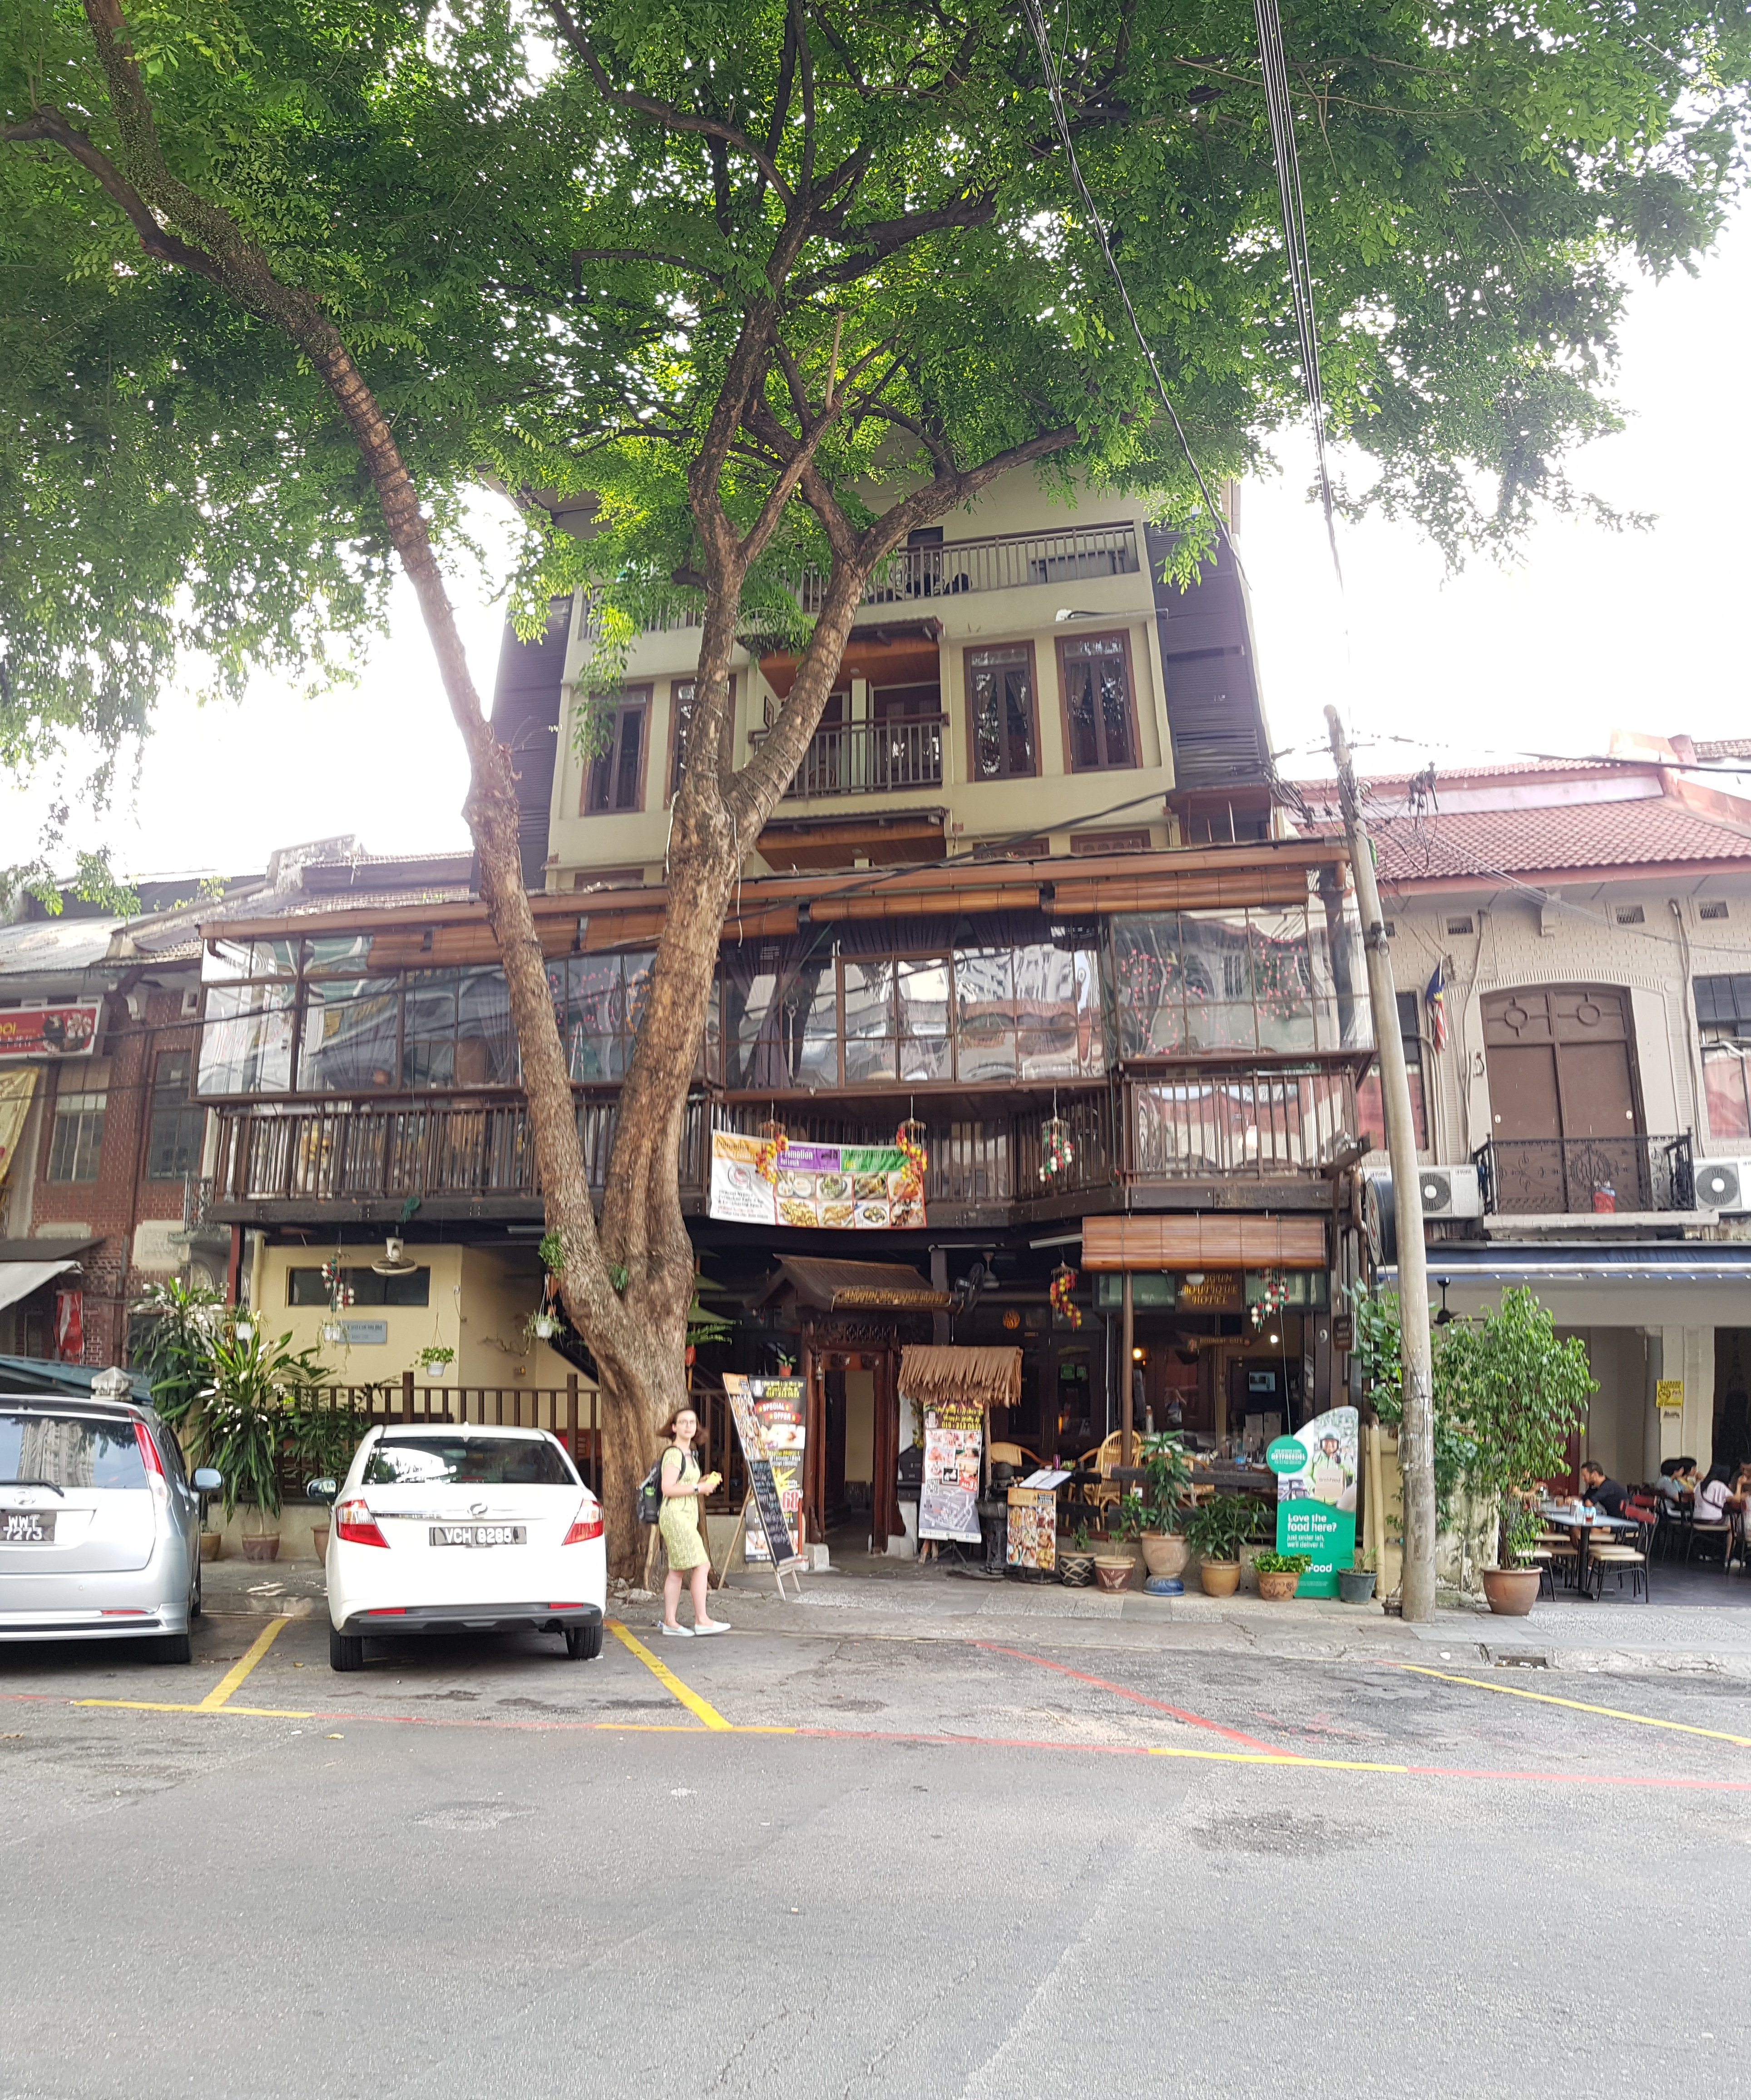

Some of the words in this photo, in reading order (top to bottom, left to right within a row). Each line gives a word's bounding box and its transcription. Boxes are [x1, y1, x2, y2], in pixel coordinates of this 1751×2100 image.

[1182, 1284, 1238, 1295] BOUTIQUE
[1192, 1294, 1227, 1305] HOTEL
[1320, 1329, 1327, 1343] 9
[762, 1402, 785, 1412] SPECIAL
[773, 1411, 791, 1421] OFFER
[782, 1491, 799, 1510] 68
[8, 1514, 40, 1529] WWT
[1288, 1513, 1310, 1522] Love
[1311, 1513, 1327, 1522] the
[1288, 1522, 1310, 1532] food
[1311, 1522, 1337, 1532] here?
[3, 1526, 43, 1540] 7273
[445, 1528, 471, 1544] VCH
